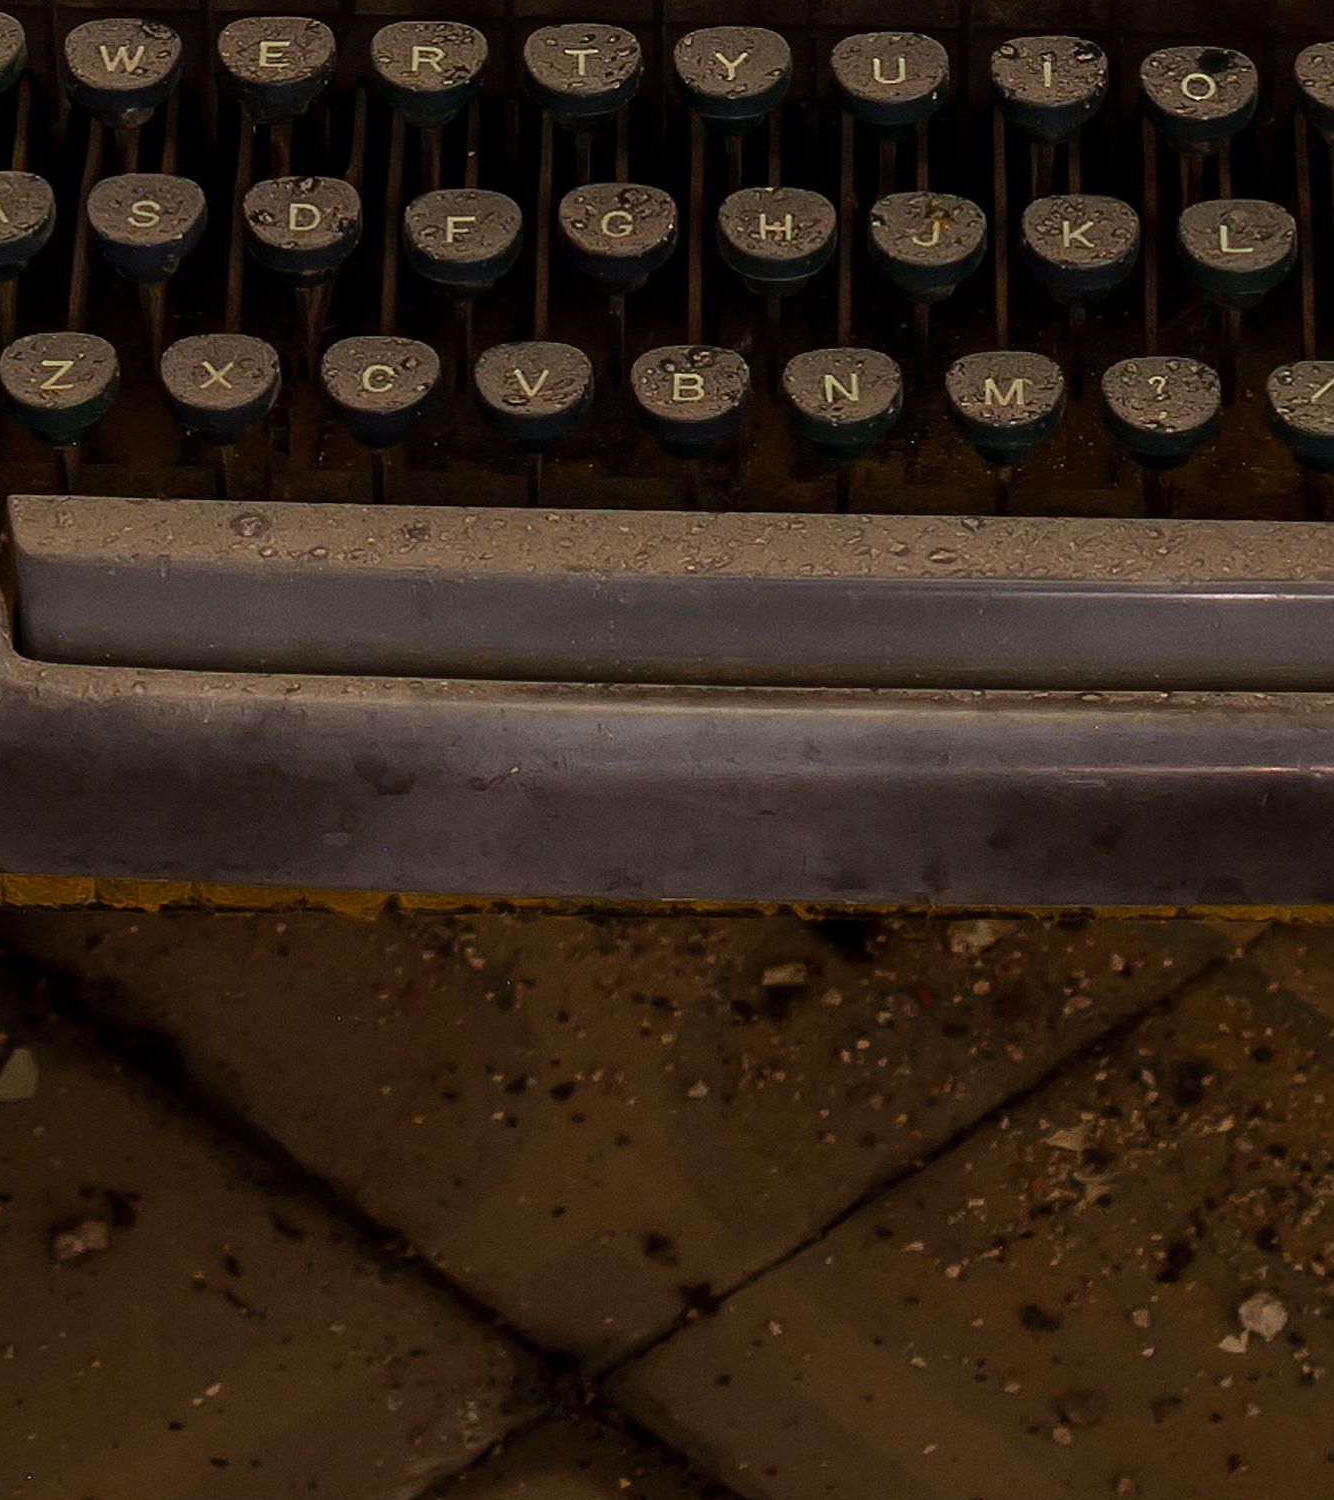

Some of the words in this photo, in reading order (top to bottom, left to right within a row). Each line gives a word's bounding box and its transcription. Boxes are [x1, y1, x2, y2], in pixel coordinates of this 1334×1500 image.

[99, 45, 146, 73] W
[259, 40, 291, 69] E
[411, 45, 443, 73] R
[565, 49, 598, 76] T
[715, 51, 748, 81] Y
[873, 57, 907, 85] U
[1181, 73, 1216, 101] O
[127, 200, 160, 228] S
[289, 203, 323, 232] D
[601, 210, 634, 237] G
[759, 214, 793, 241] H
[446, 215, 476, 244] F
[911, 219, 945, 248] J
[1061, 220, 1095, 249] K
[1220, 224, 1255, 254] L
[40, 360, 74, 390] Z
[201, 360, 235, 389] X
[361, 364, 395, 393] C
[513, 369, 549, 398] V
[672, 373, 706, 402] B
[823, 373, 860, 402] N
[983, 378, 1026, 406] M
